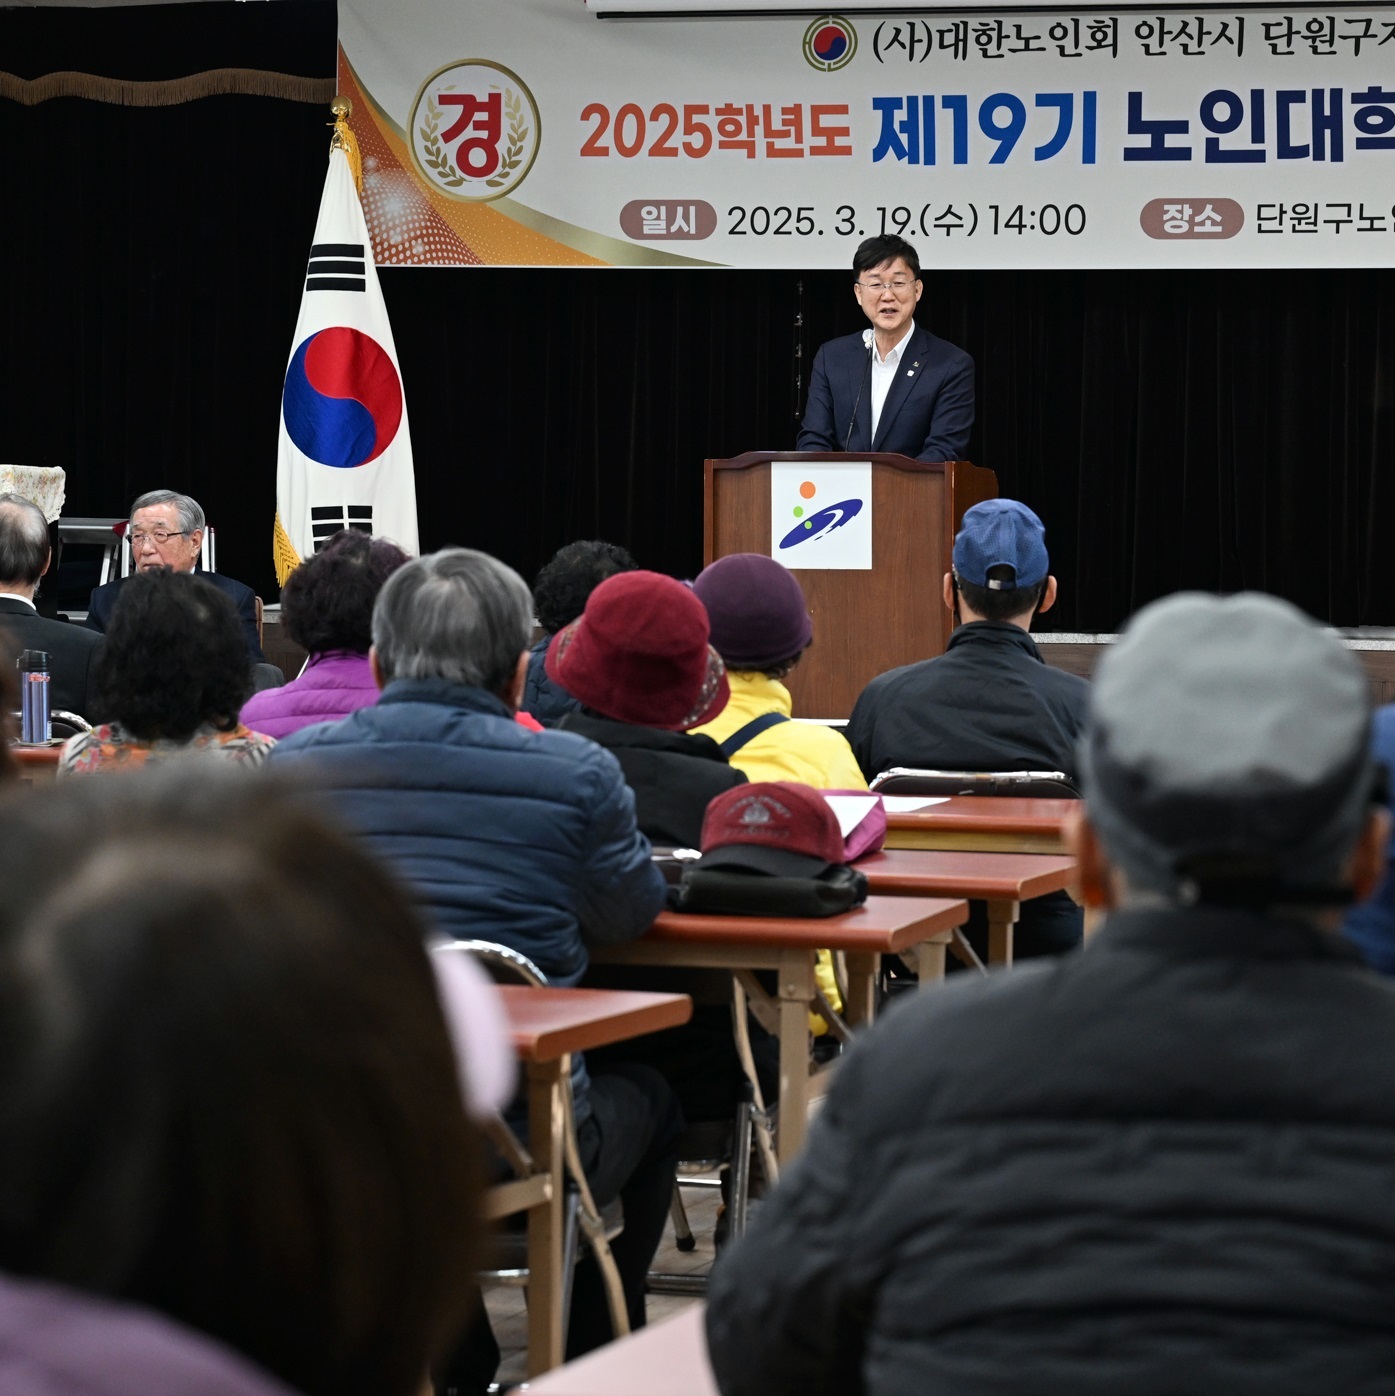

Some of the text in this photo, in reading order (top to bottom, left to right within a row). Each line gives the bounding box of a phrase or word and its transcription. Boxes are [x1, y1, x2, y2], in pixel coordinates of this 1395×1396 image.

[872, 18, 1118, 63] (사)대한노인회
[1133, 13, 1245, 58] 안산시
[436, 94, 503, 179] 경
[580, 103, 852, 158] 2025학년도
[872, 91, 1097, 165] 제19기
[641, 206, 695, 234] 일시
[989, 204, 1086, 235] 14:00
[1163, 204, 1222, 233] 장소
